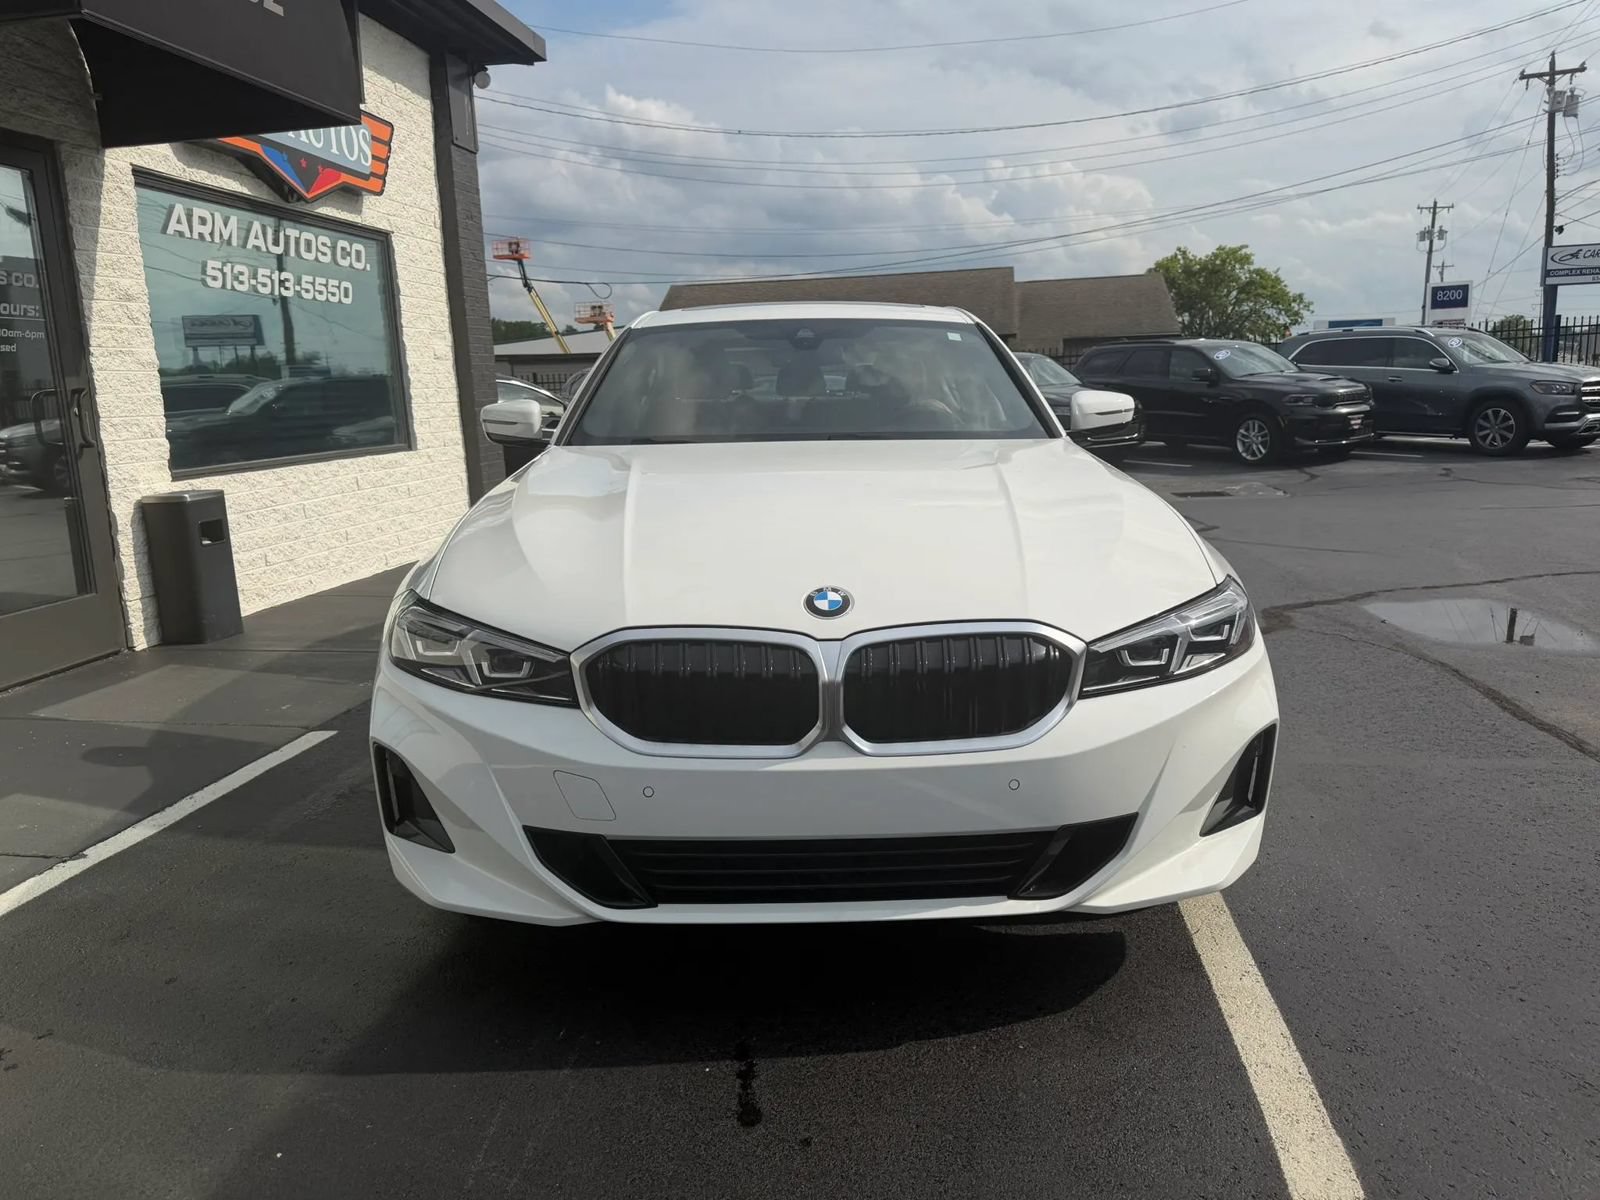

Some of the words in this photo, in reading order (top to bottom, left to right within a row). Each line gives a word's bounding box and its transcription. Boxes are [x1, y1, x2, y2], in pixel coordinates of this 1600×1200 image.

[166, 203, 238, 247] ARM
[246, 221, 332, 264] AUTOS
[336, 239, 371, 272] CO.
[206, 260, 353, 305] 513-513-5550
[1437, 289, 1463, 301] 8200
[0, 328, 45, 339] 0am-6pm
